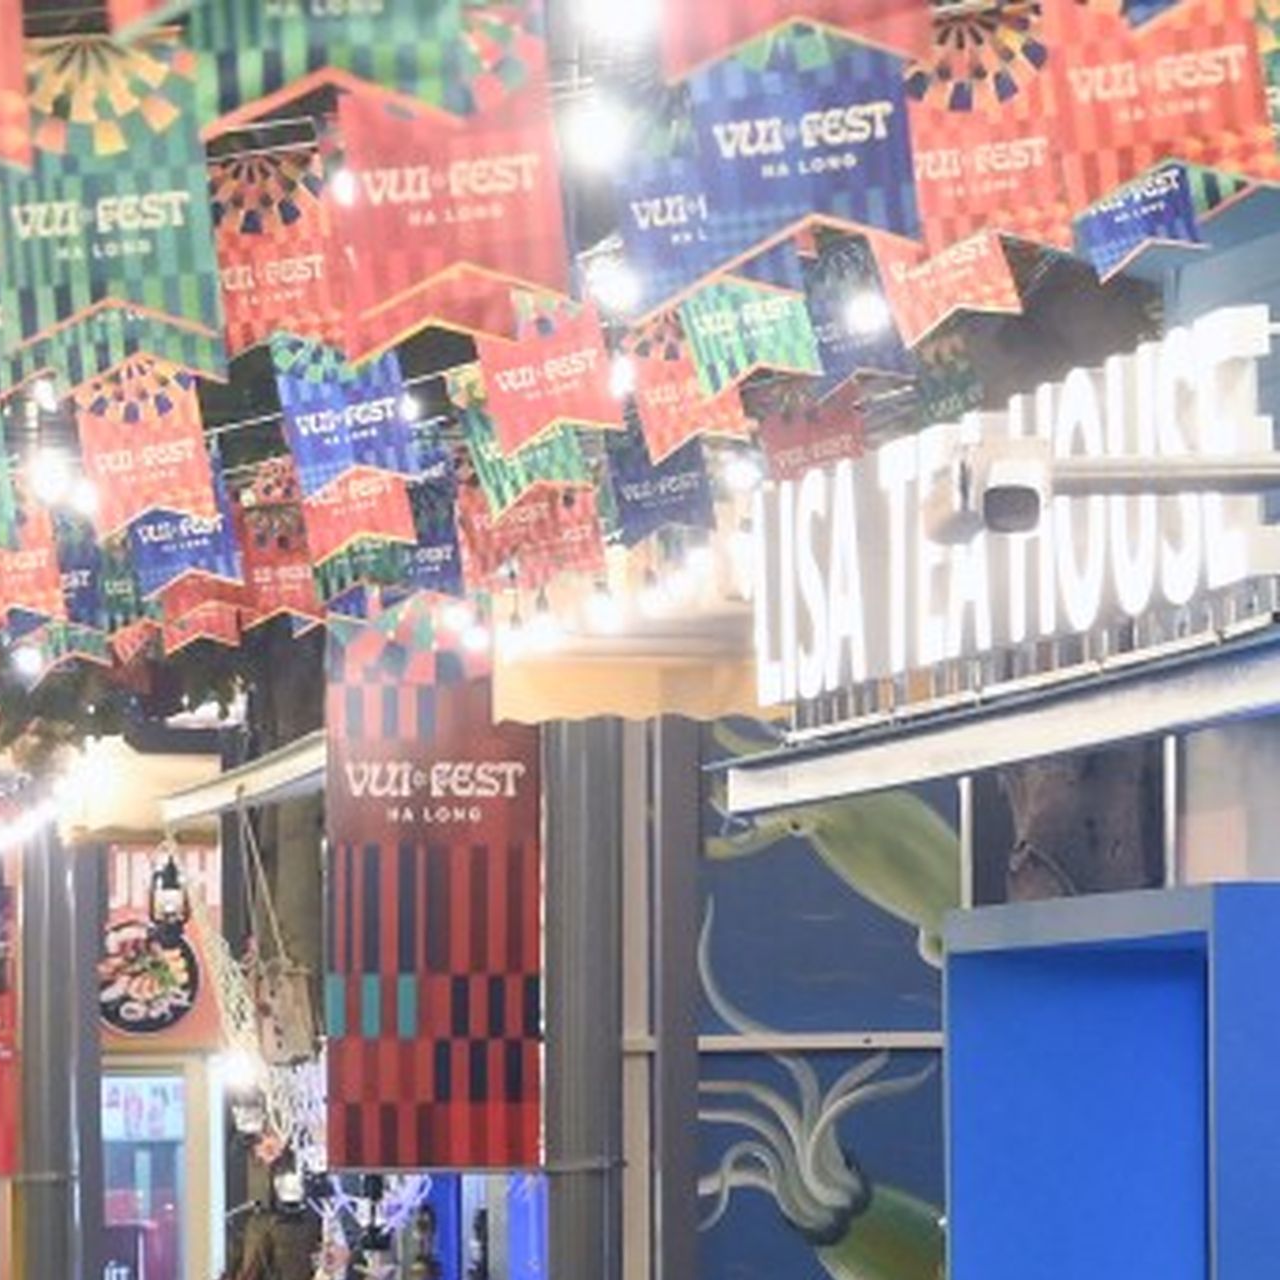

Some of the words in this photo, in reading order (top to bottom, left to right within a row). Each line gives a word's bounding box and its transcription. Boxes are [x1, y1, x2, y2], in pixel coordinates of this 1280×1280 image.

[1069, 64, 1137, 102] VUI
[1156, 45, 1246, 88] FEST
[713, 119, 783, 159] VUI
[801, 101, 893, 148] FEST
[761, 163, 790, 178] HA
[798, 153, 858, 175] LONG
[975, 138, 1048, 173] FEST
[364, 167, 433, 206] VUI
[450, 154, 539, 196] FEST
[12, 205, 80, 240] VUI
[97, 191, 189, 232] FEST
[630, 196, 684, 229] VUI
[93, 240, 152, 259] LONG
[266, 256, 325, 284] FEST
[545, 348, 598, 378] FEST
[296, 409, 338, 436] VUI
[346, 396, 396, 427] FEST
[752, 458, 867, 703] LISA
[879, 411, 992, 673] TEA
[1009, 305, 1270, 643] HOUSE
[346, 761, 412, 797] VUI
[430, 761, 526, 797] FEST
[388, 806, 414, 822] HA
[424, 806, 482, 822] LONG
